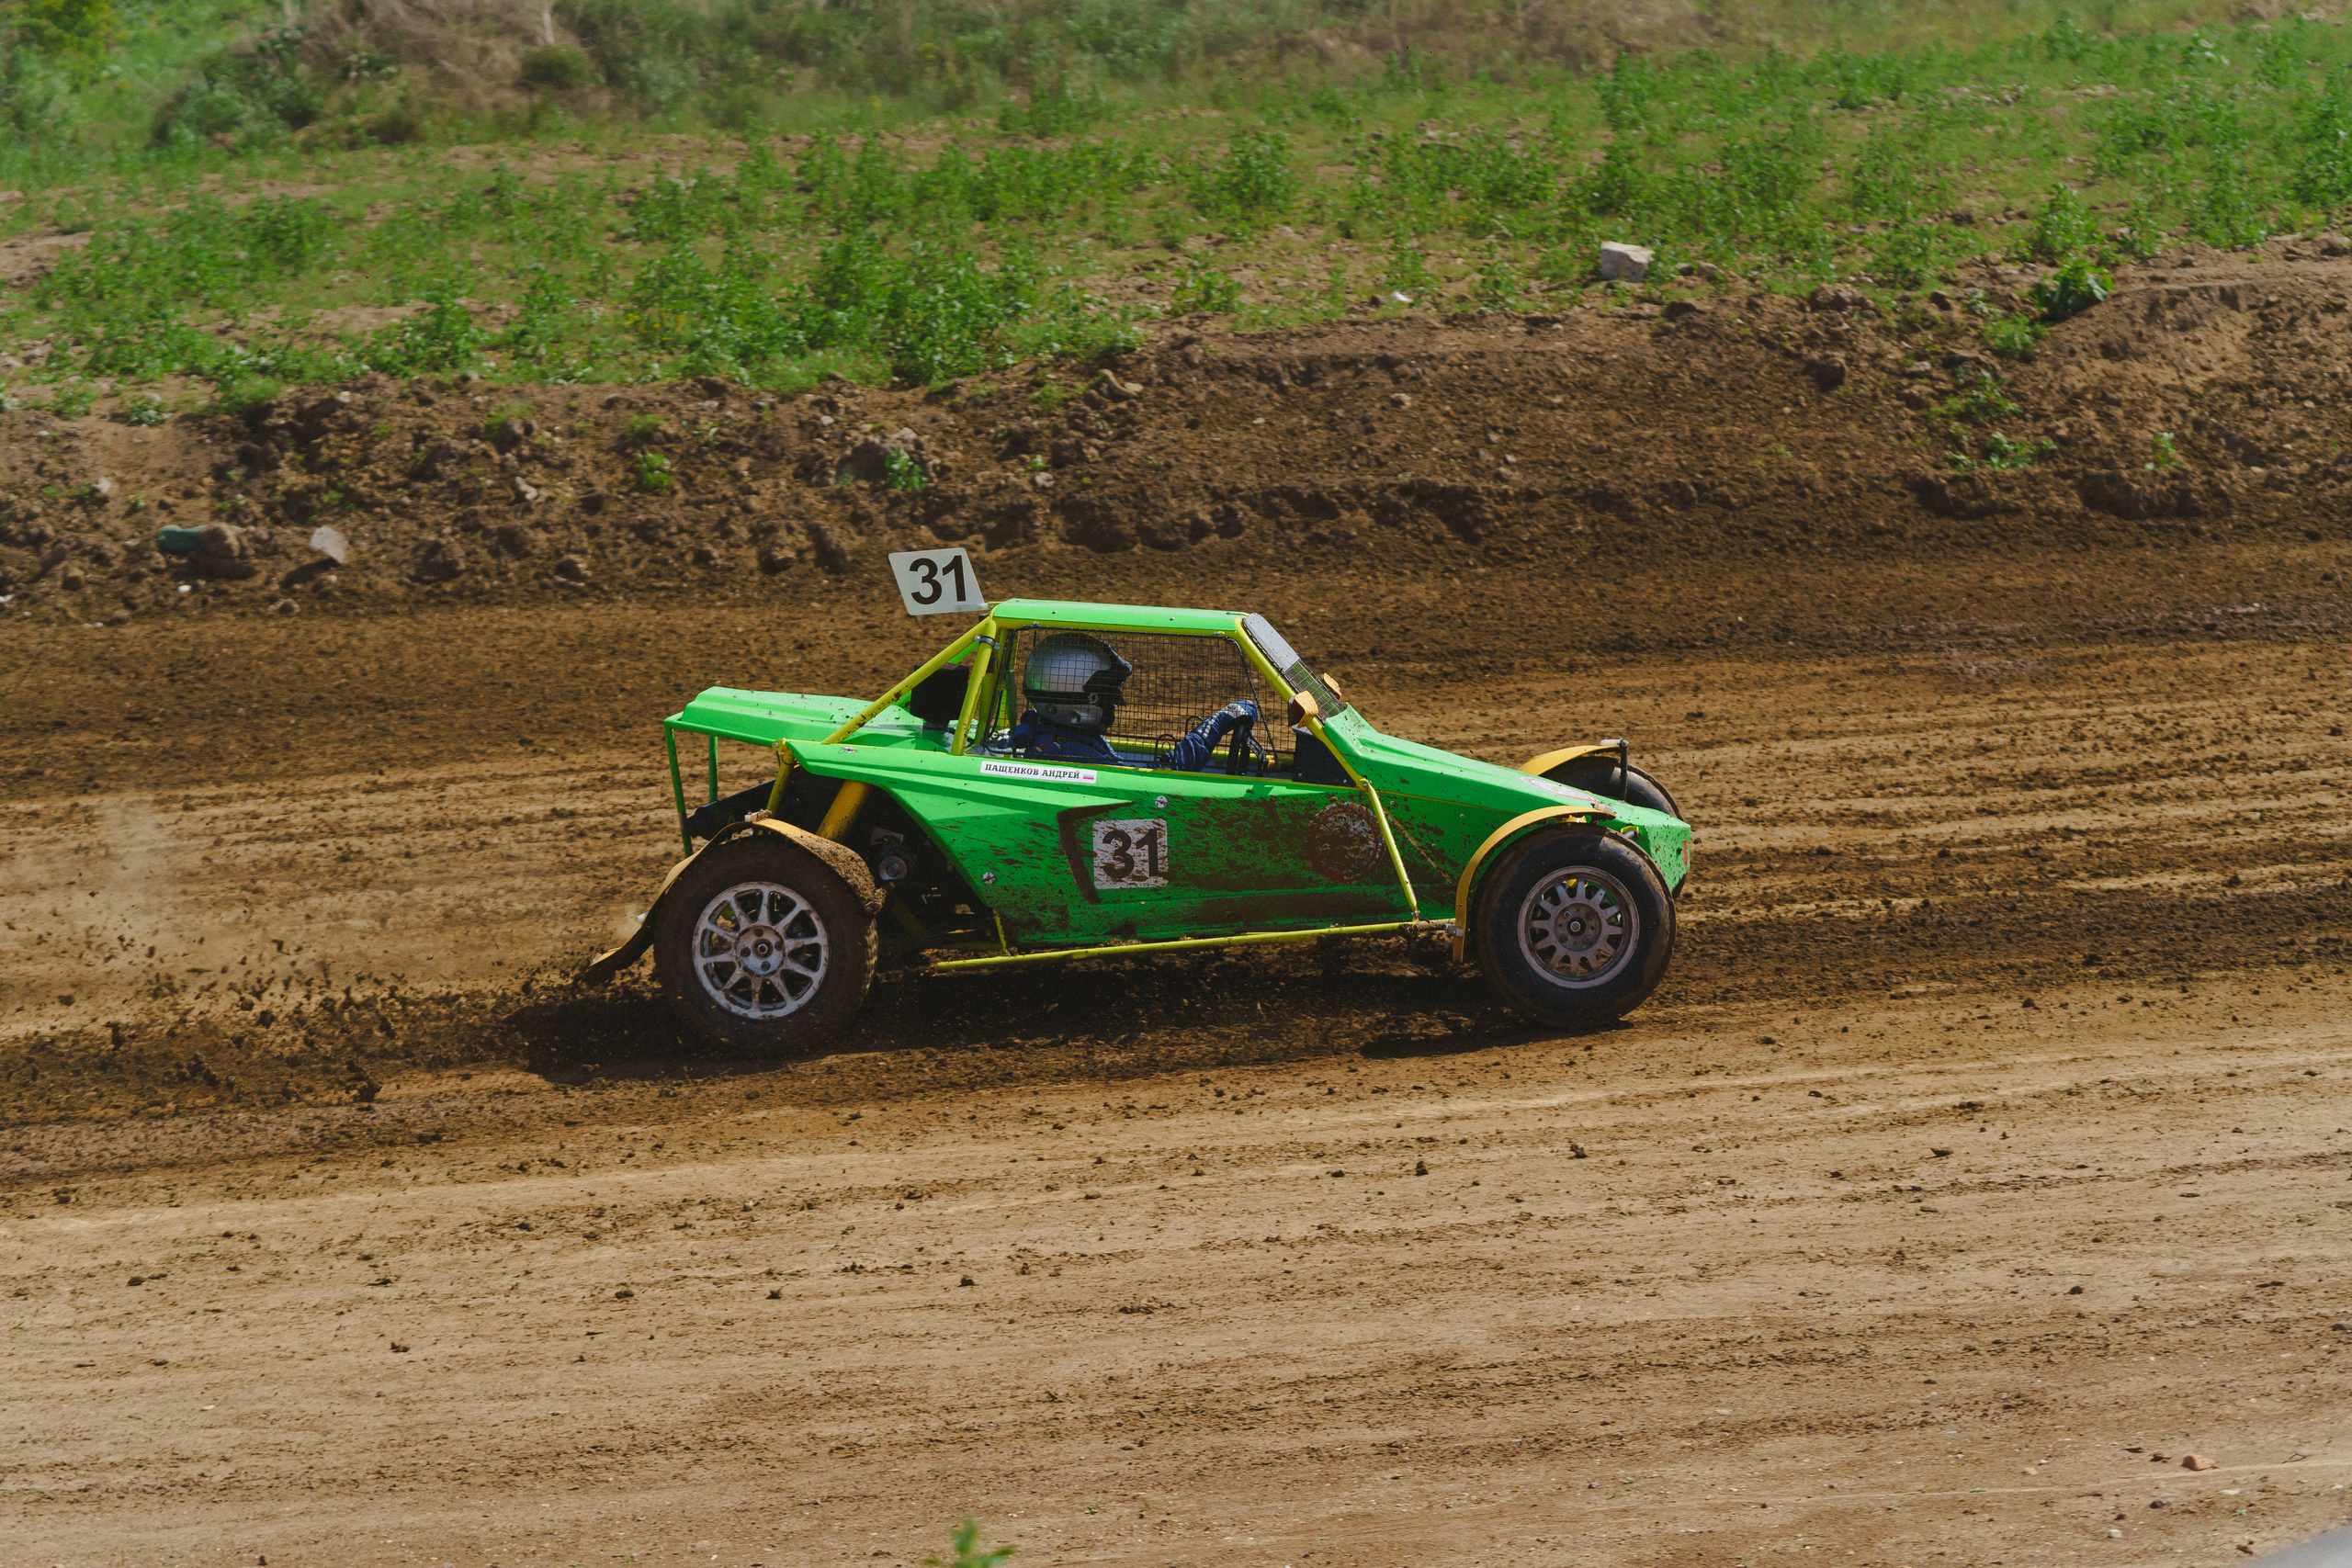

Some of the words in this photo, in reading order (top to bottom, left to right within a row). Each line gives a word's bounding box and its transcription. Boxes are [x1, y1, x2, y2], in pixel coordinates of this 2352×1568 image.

[909, 555, 967, 605] 31
[985, 764, 1039, 775] ПАЩЕНКОВ
[1042, 770, 1080, 779] АНДРЕЙ
[1102, 829, 1159, 879] 31
